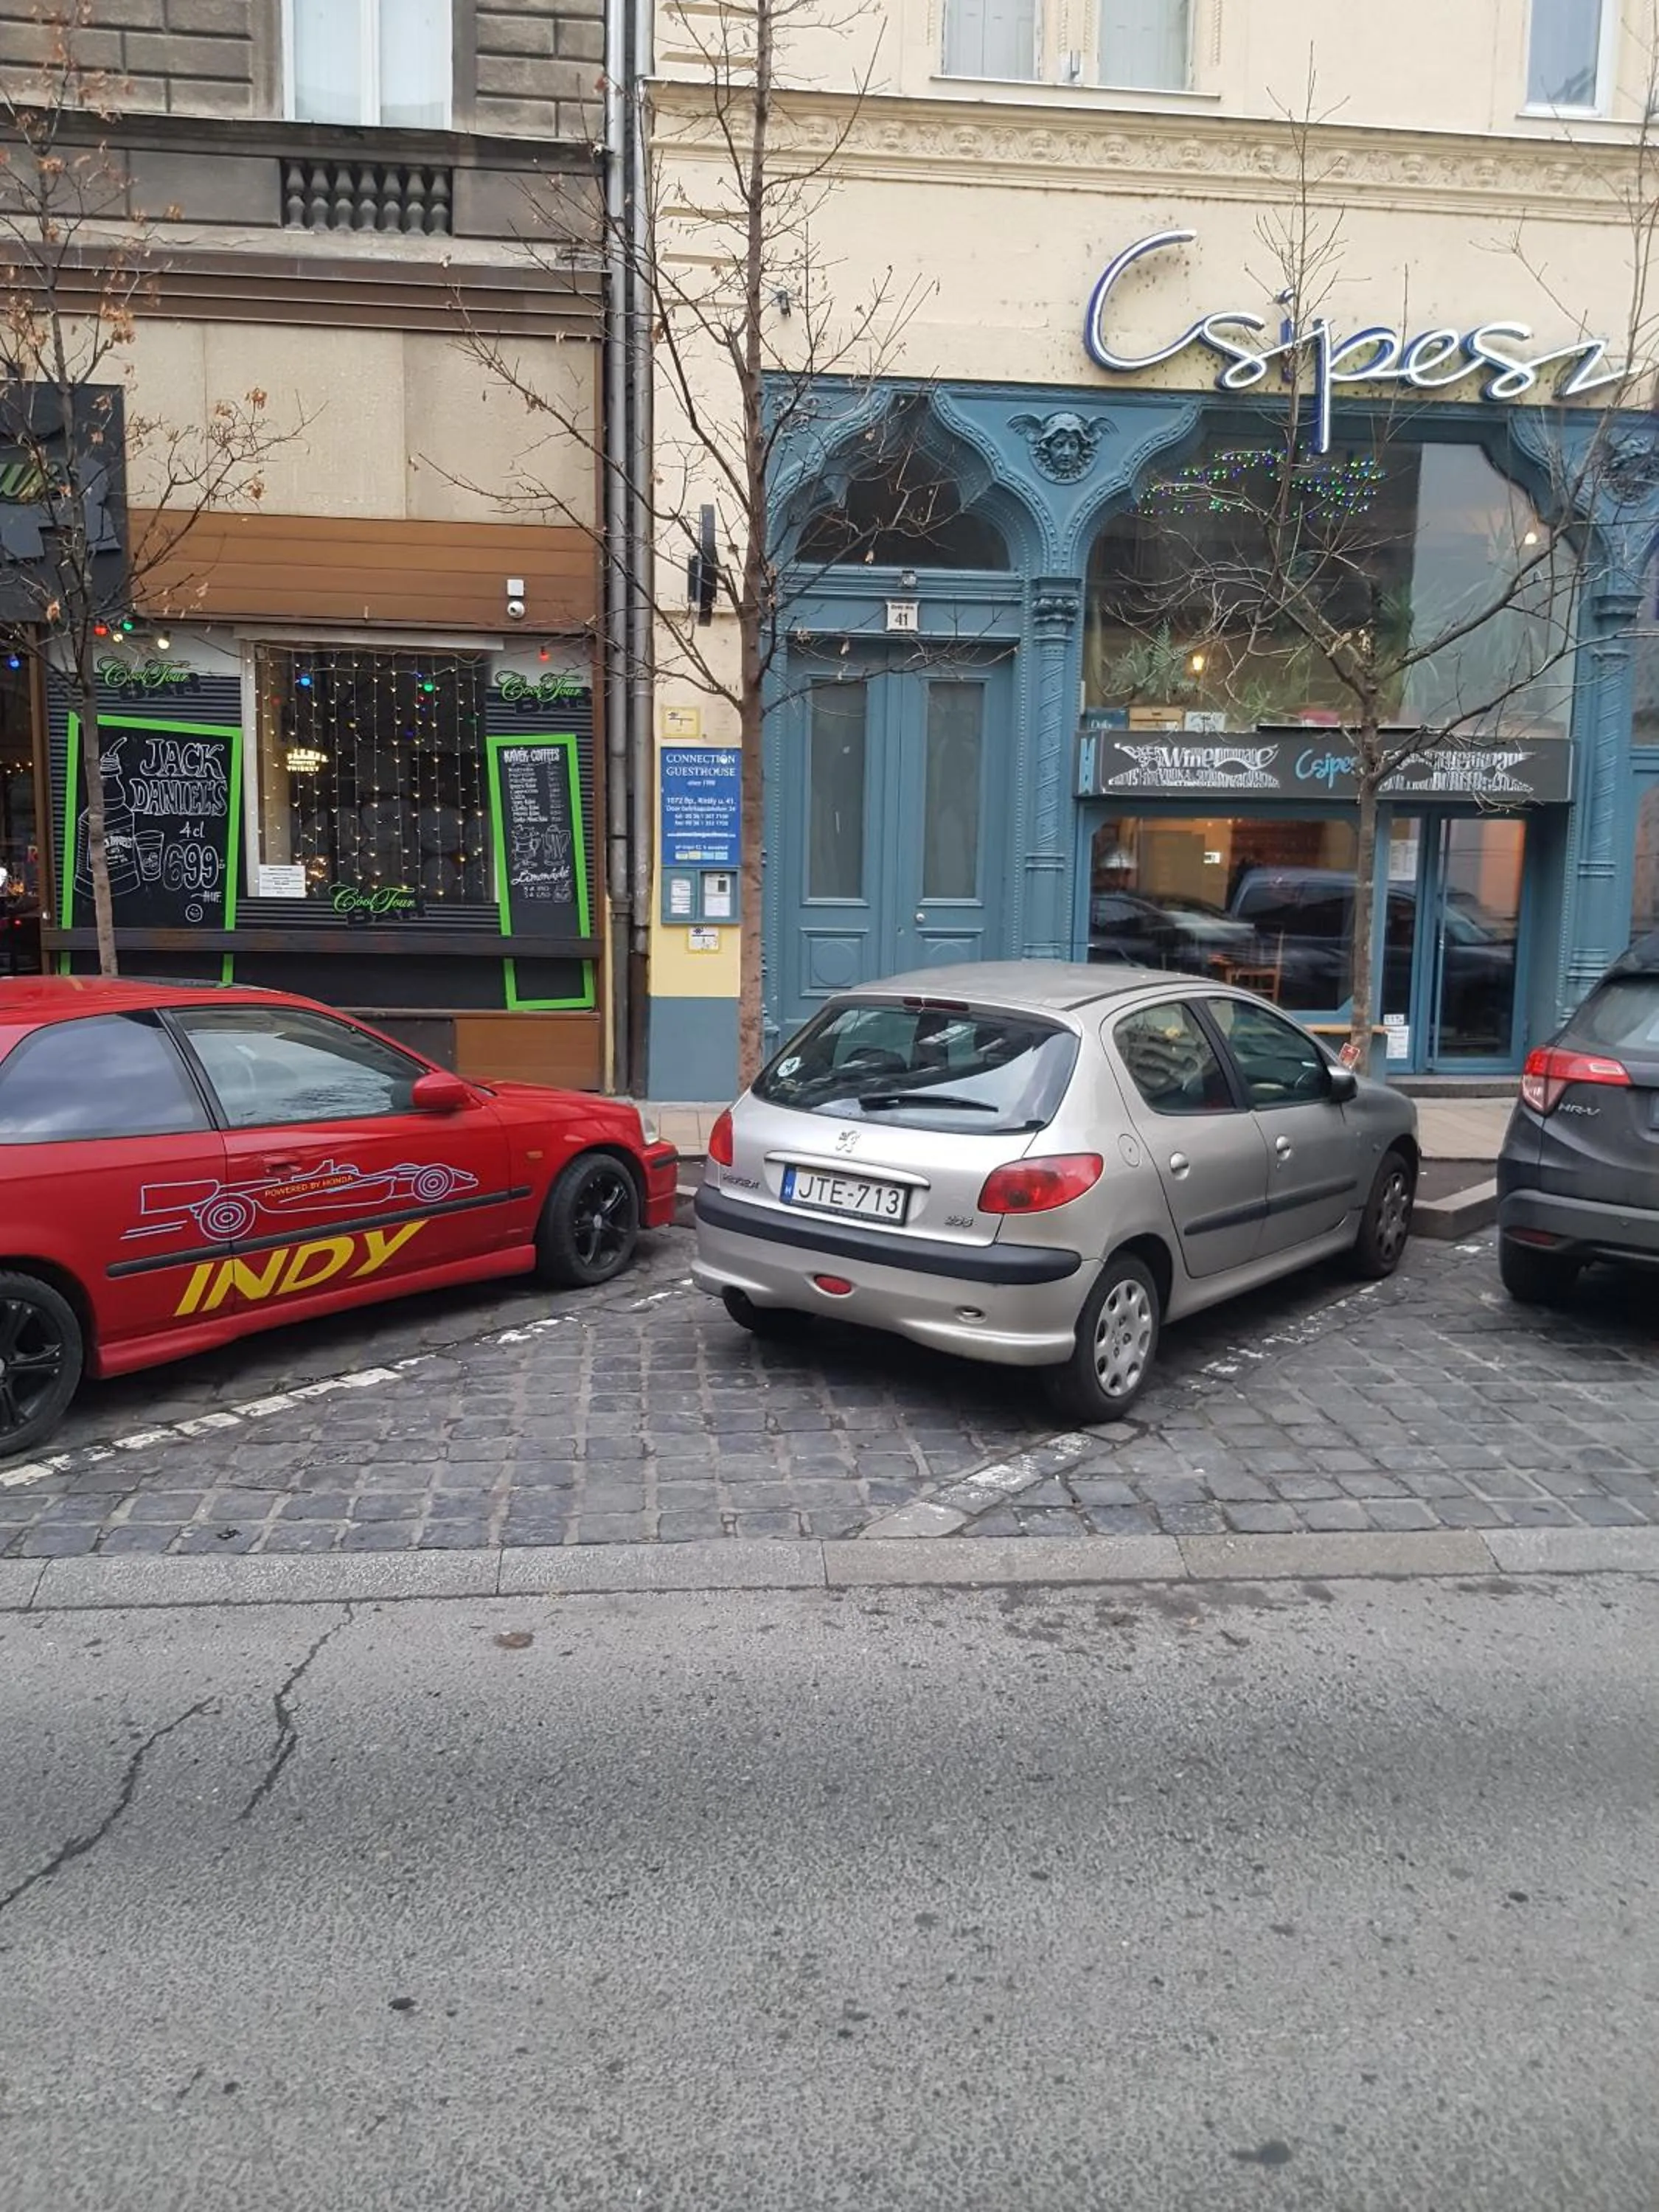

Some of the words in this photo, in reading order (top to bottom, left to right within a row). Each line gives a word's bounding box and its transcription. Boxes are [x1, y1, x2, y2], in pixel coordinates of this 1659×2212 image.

[1084, 229, 1644, 455] Csipesz
[894, 613, 908, 626] 41
[139, 738, 226, 779] JACK
[666, 754, 736, 764] CONNECTION
[666, 766, 736, 776] GUESTHOUSE
[1295, 748, 1361, 788] Csipes
[129, 778, 228, 816] DANIEL'S
[179, 821, 189, 838] 4
[192, 821, 205, 838] cl
[162, 843, 219, 891] 699
[1558, 1103, 1601, 1116] HR-V
[265, 1183, 307, 1197] POWERED
[322, 1175, 353, 1186] HONDA
[798, 1177, 900, 1215] JTE-713
[174, 1219, 429, 1317] INDY
